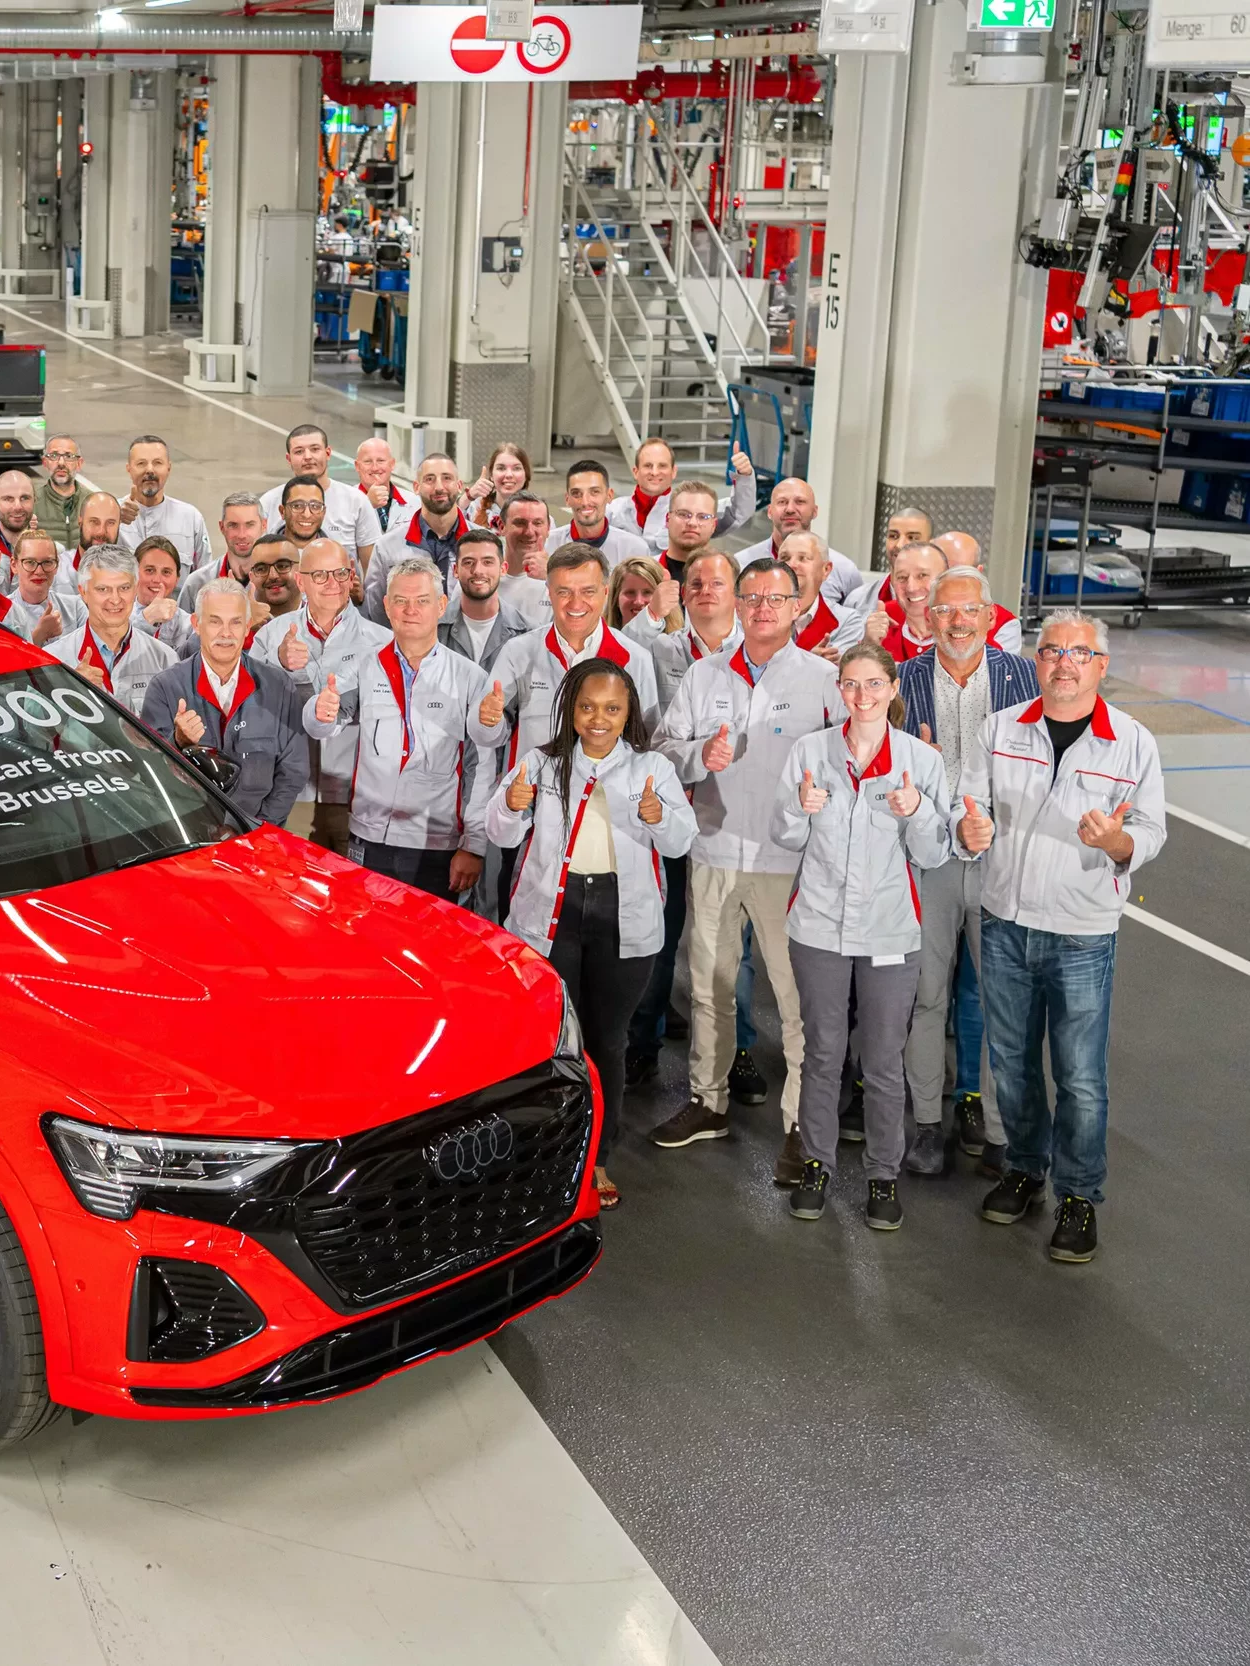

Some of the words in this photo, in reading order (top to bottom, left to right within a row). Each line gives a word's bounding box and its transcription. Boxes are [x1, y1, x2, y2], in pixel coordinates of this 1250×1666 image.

[1166, 20, 1205, 41] Menge:
[1230, 14, 1246, 34] 60
[828, 253, 841, 288] E
[825, 294, 840, 330] 15
[53, 746, 134, 773] from
